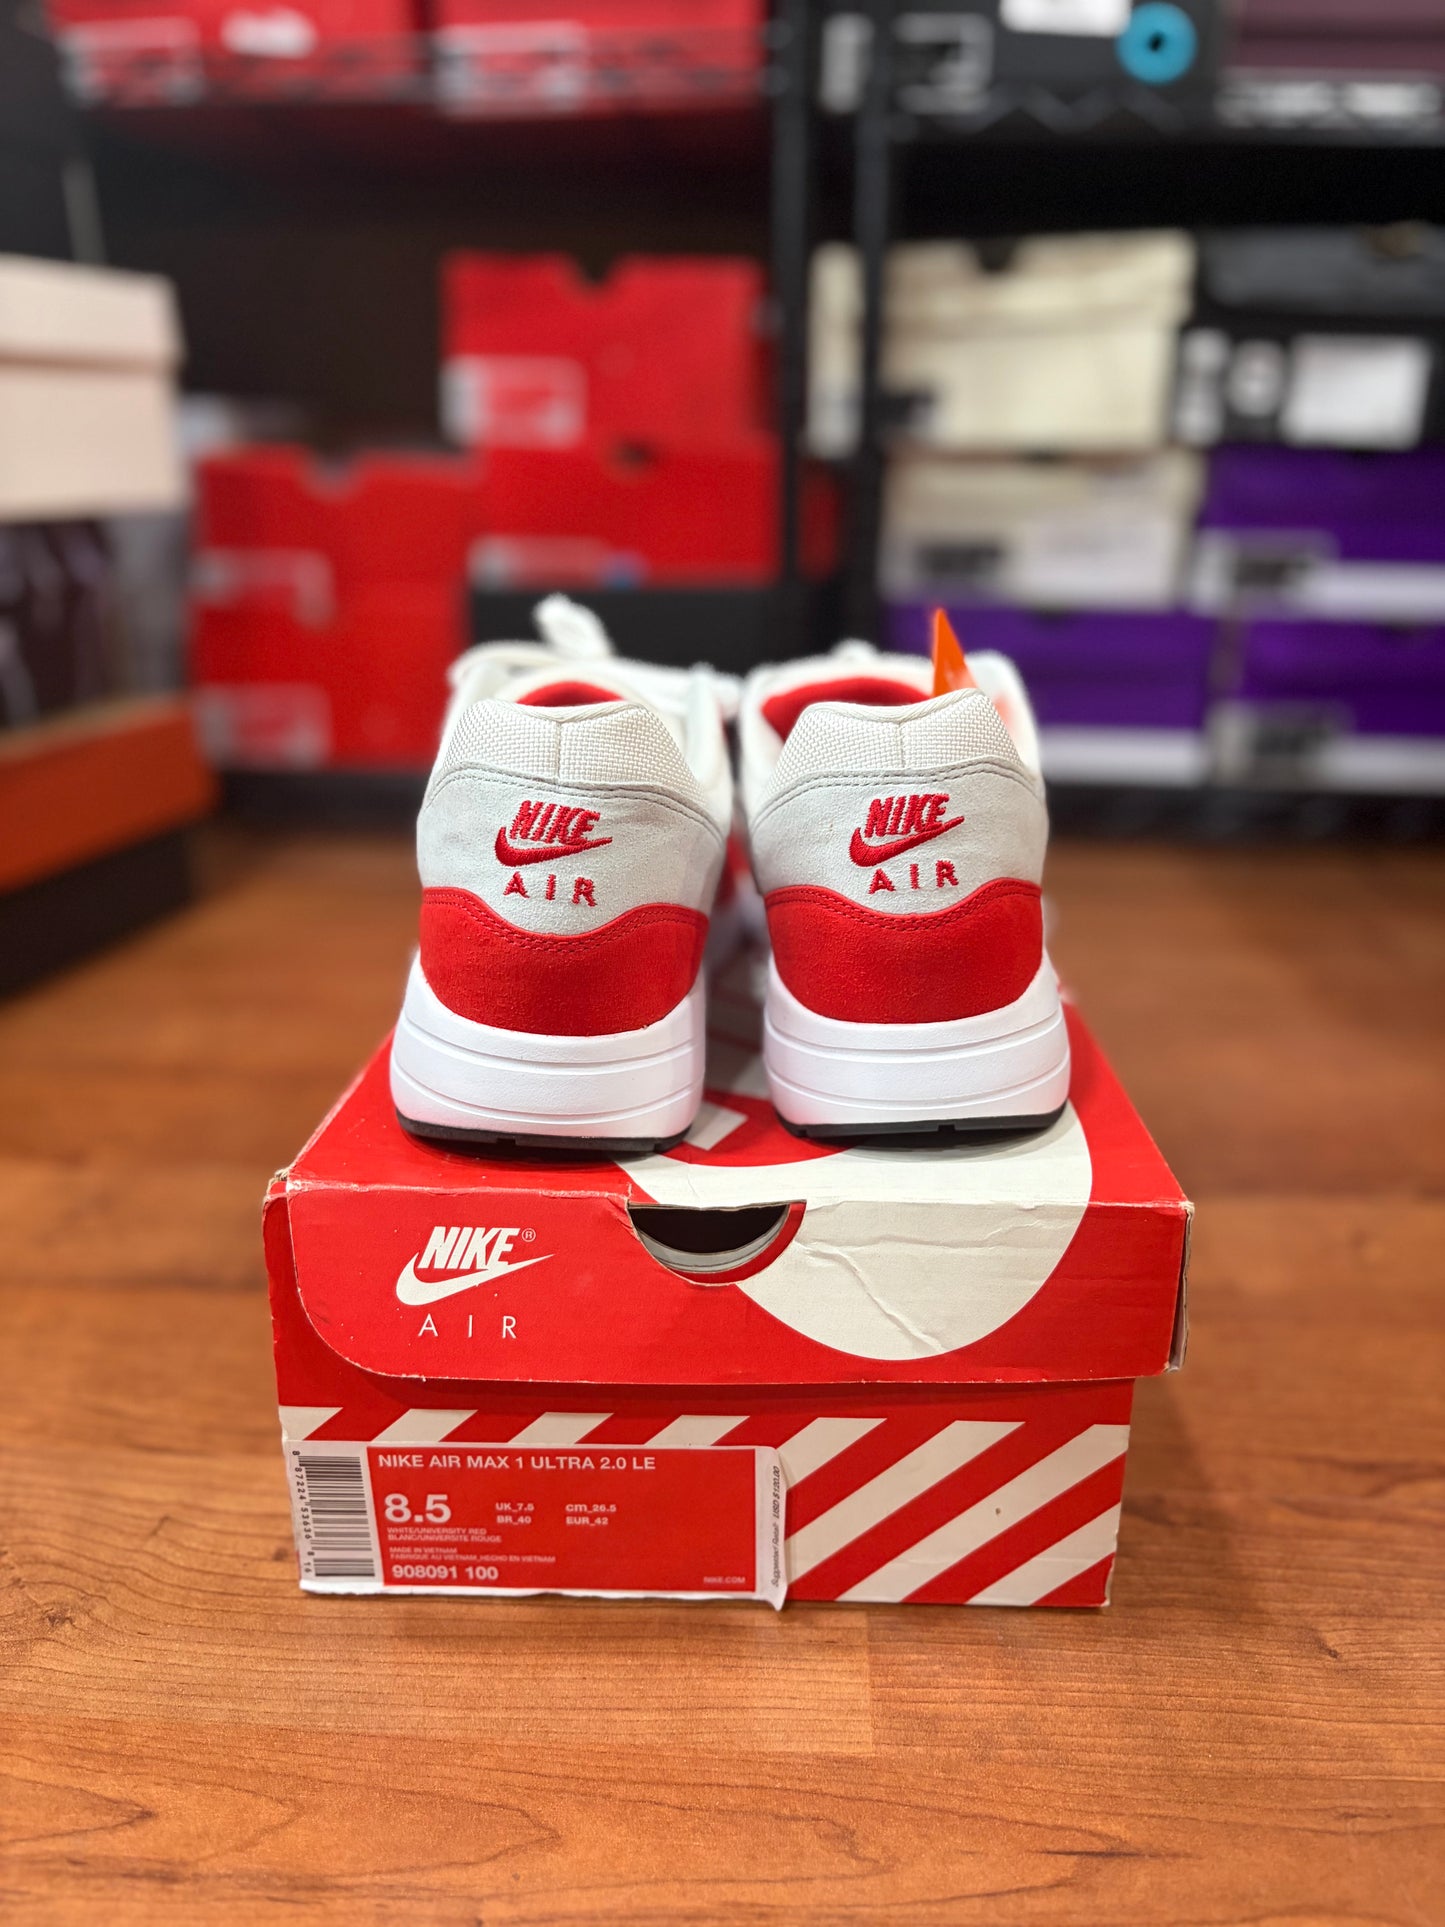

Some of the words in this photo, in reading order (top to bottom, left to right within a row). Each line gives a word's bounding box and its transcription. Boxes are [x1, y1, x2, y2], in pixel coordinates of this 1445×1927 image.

[510, 800, 600, 845] NIKE
[865, 794, 950, 838] NIKE
[503, 871, 597, 907] AIR
[868, 860, 959, 894] AIR
[417, 1226, 521, 1270] NIKE
[418, 1313, 517, 1339] AIR
[378, 1454, 424, 1468] NIKE
[429, 1455, 461, 1468] AIR
[467, 1455, 510, 1469] MAX
[515, 1456, 523, 1469] 1
[531, 1456, 595, 1470] ULTRA
[600, 1456, 627, 1470] 2.0
[632, 1457, 656, 1470] LE
[384, 1492, 452, 1523] 8.5
[565, 1503, 617, 1514] cm_26.5
[468, 1528, 488, 1536] RED
[392, 1565, 457, 1579] 908091
[465, 1566, 499, 1580] 100
[703, 1576, 746, 1584] NIKE.COM
